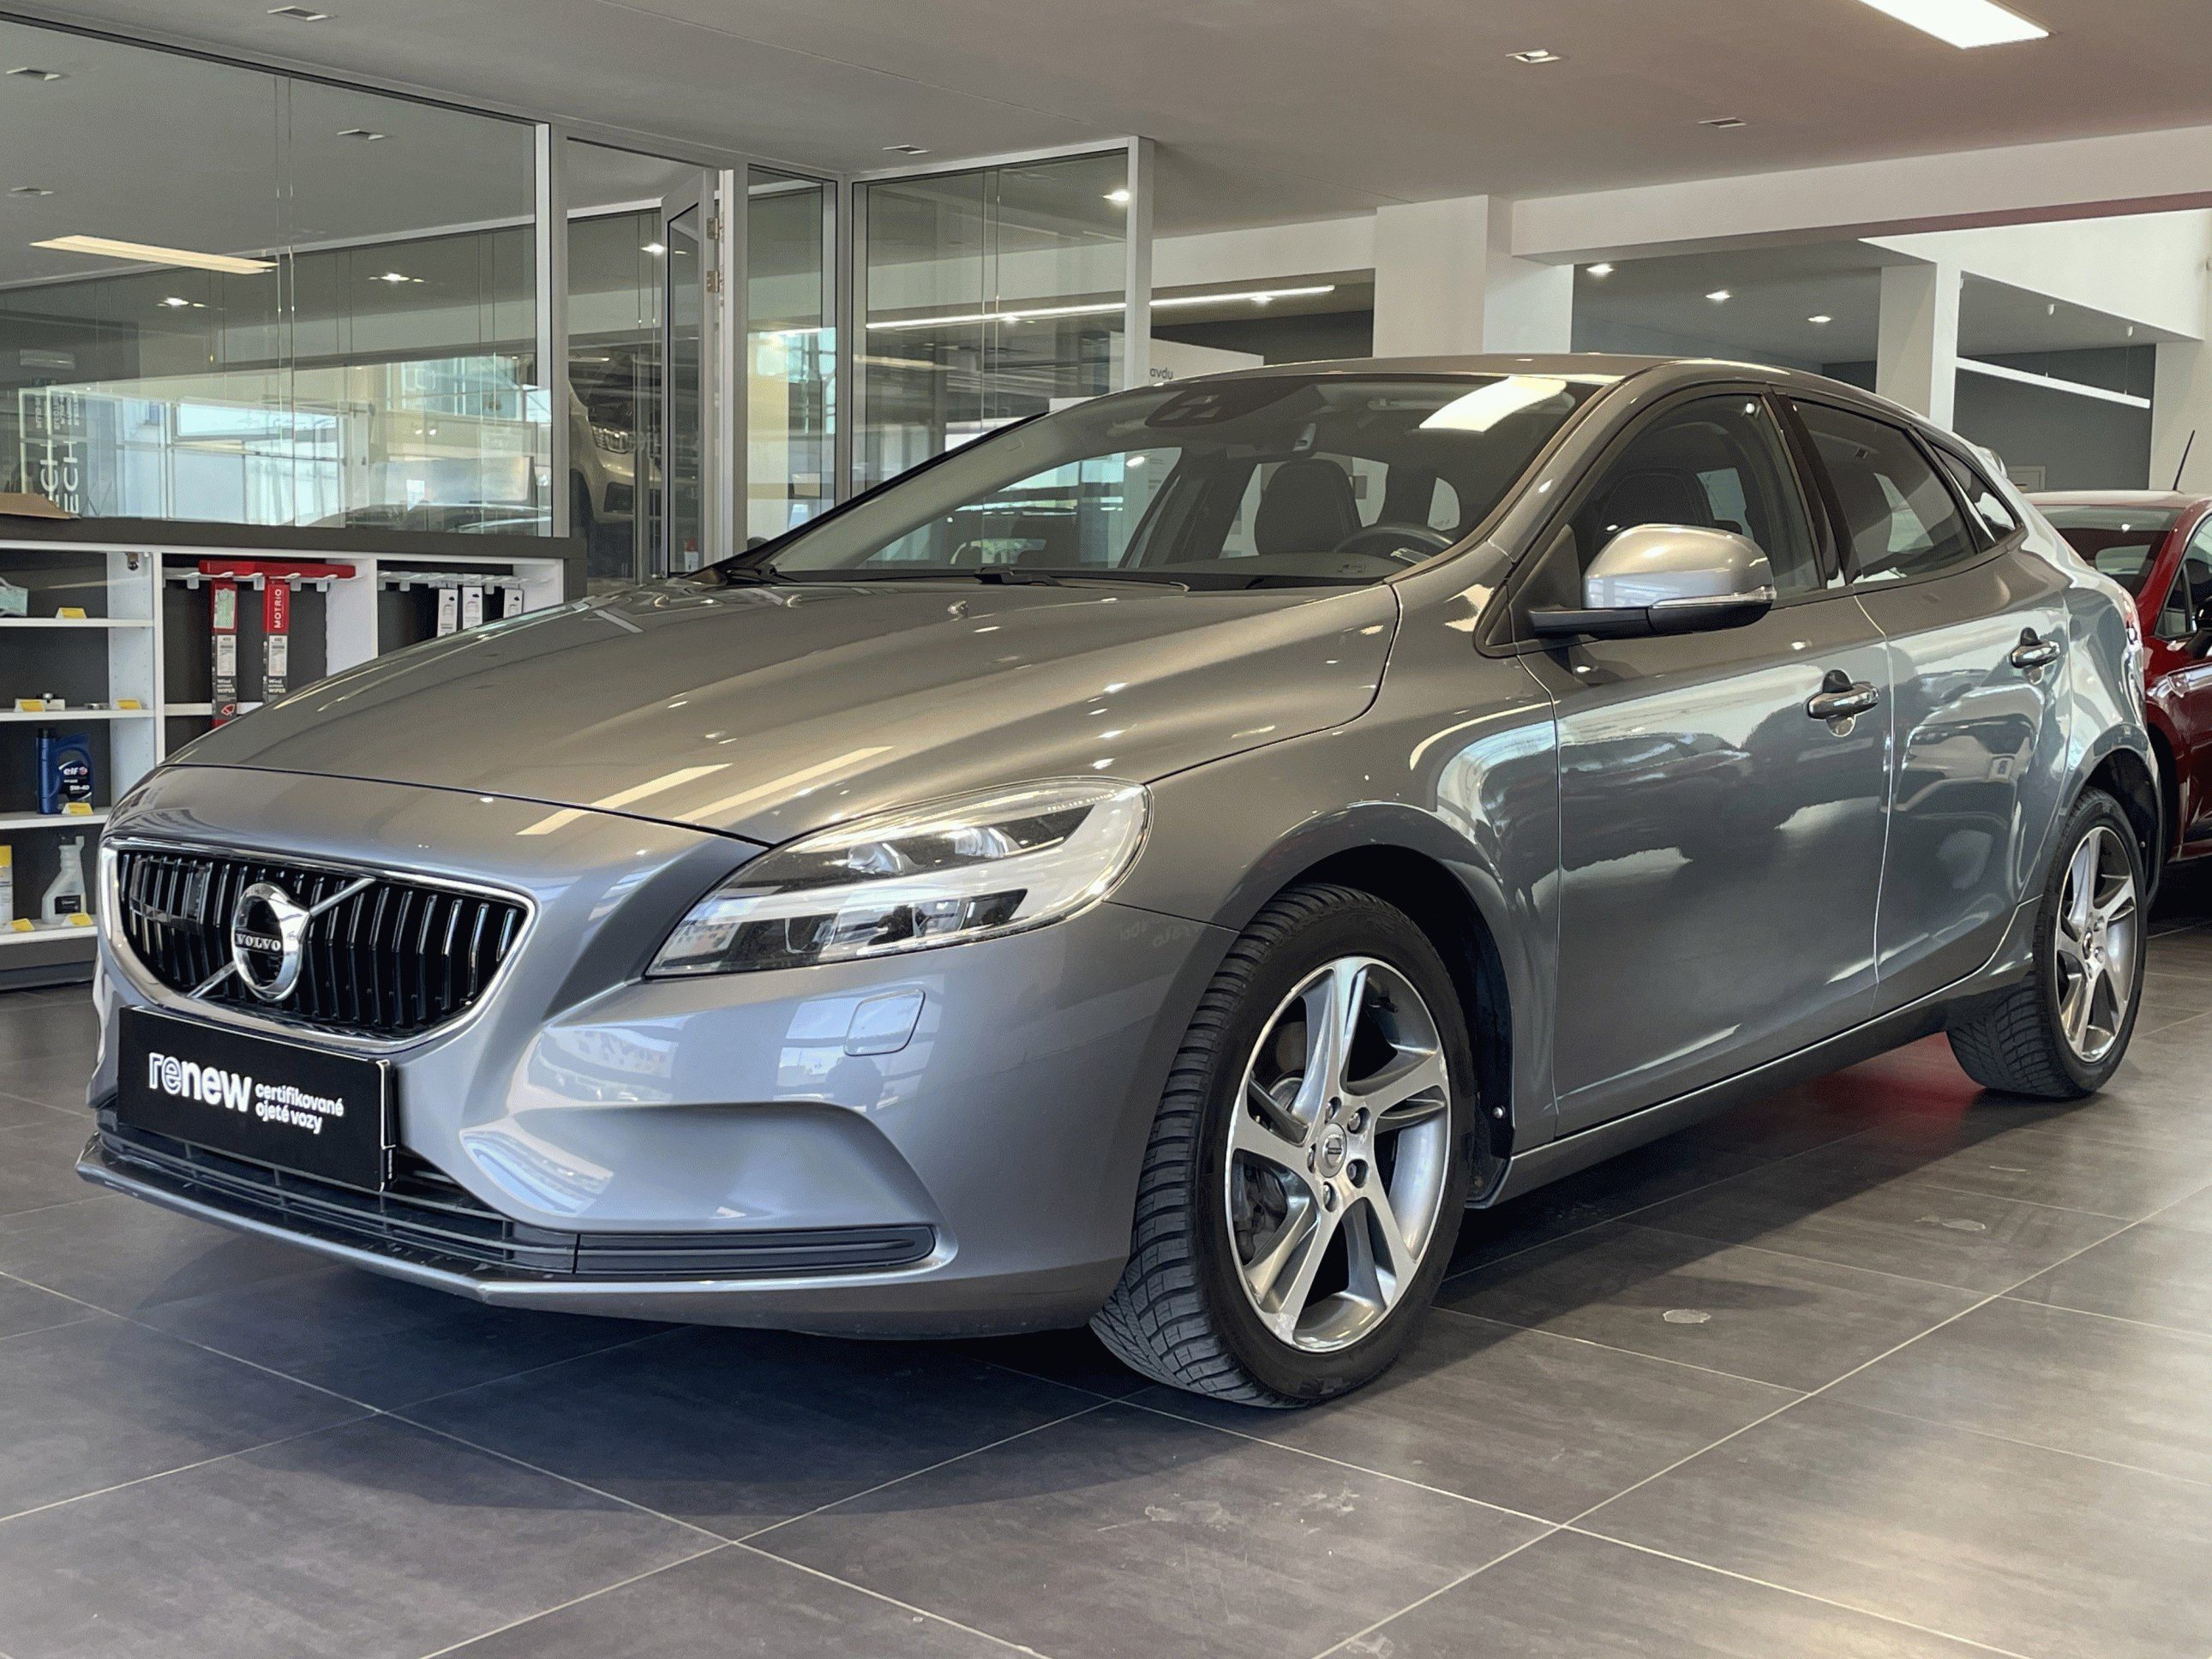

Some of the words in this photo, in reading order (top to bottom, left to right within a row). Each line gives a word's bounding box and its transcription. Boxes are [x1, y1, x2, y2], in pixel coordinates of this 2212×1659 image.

[63, 767, 79, 776] elf
[236, 933, 281, 951] VOLVO
[148, 1051, 252, 1112] renew
[255, 1083, 344, 1117] certifikované
[255, 1100, 290, 1122] ojeté
[291, 1109, 322, 1135] vozy
